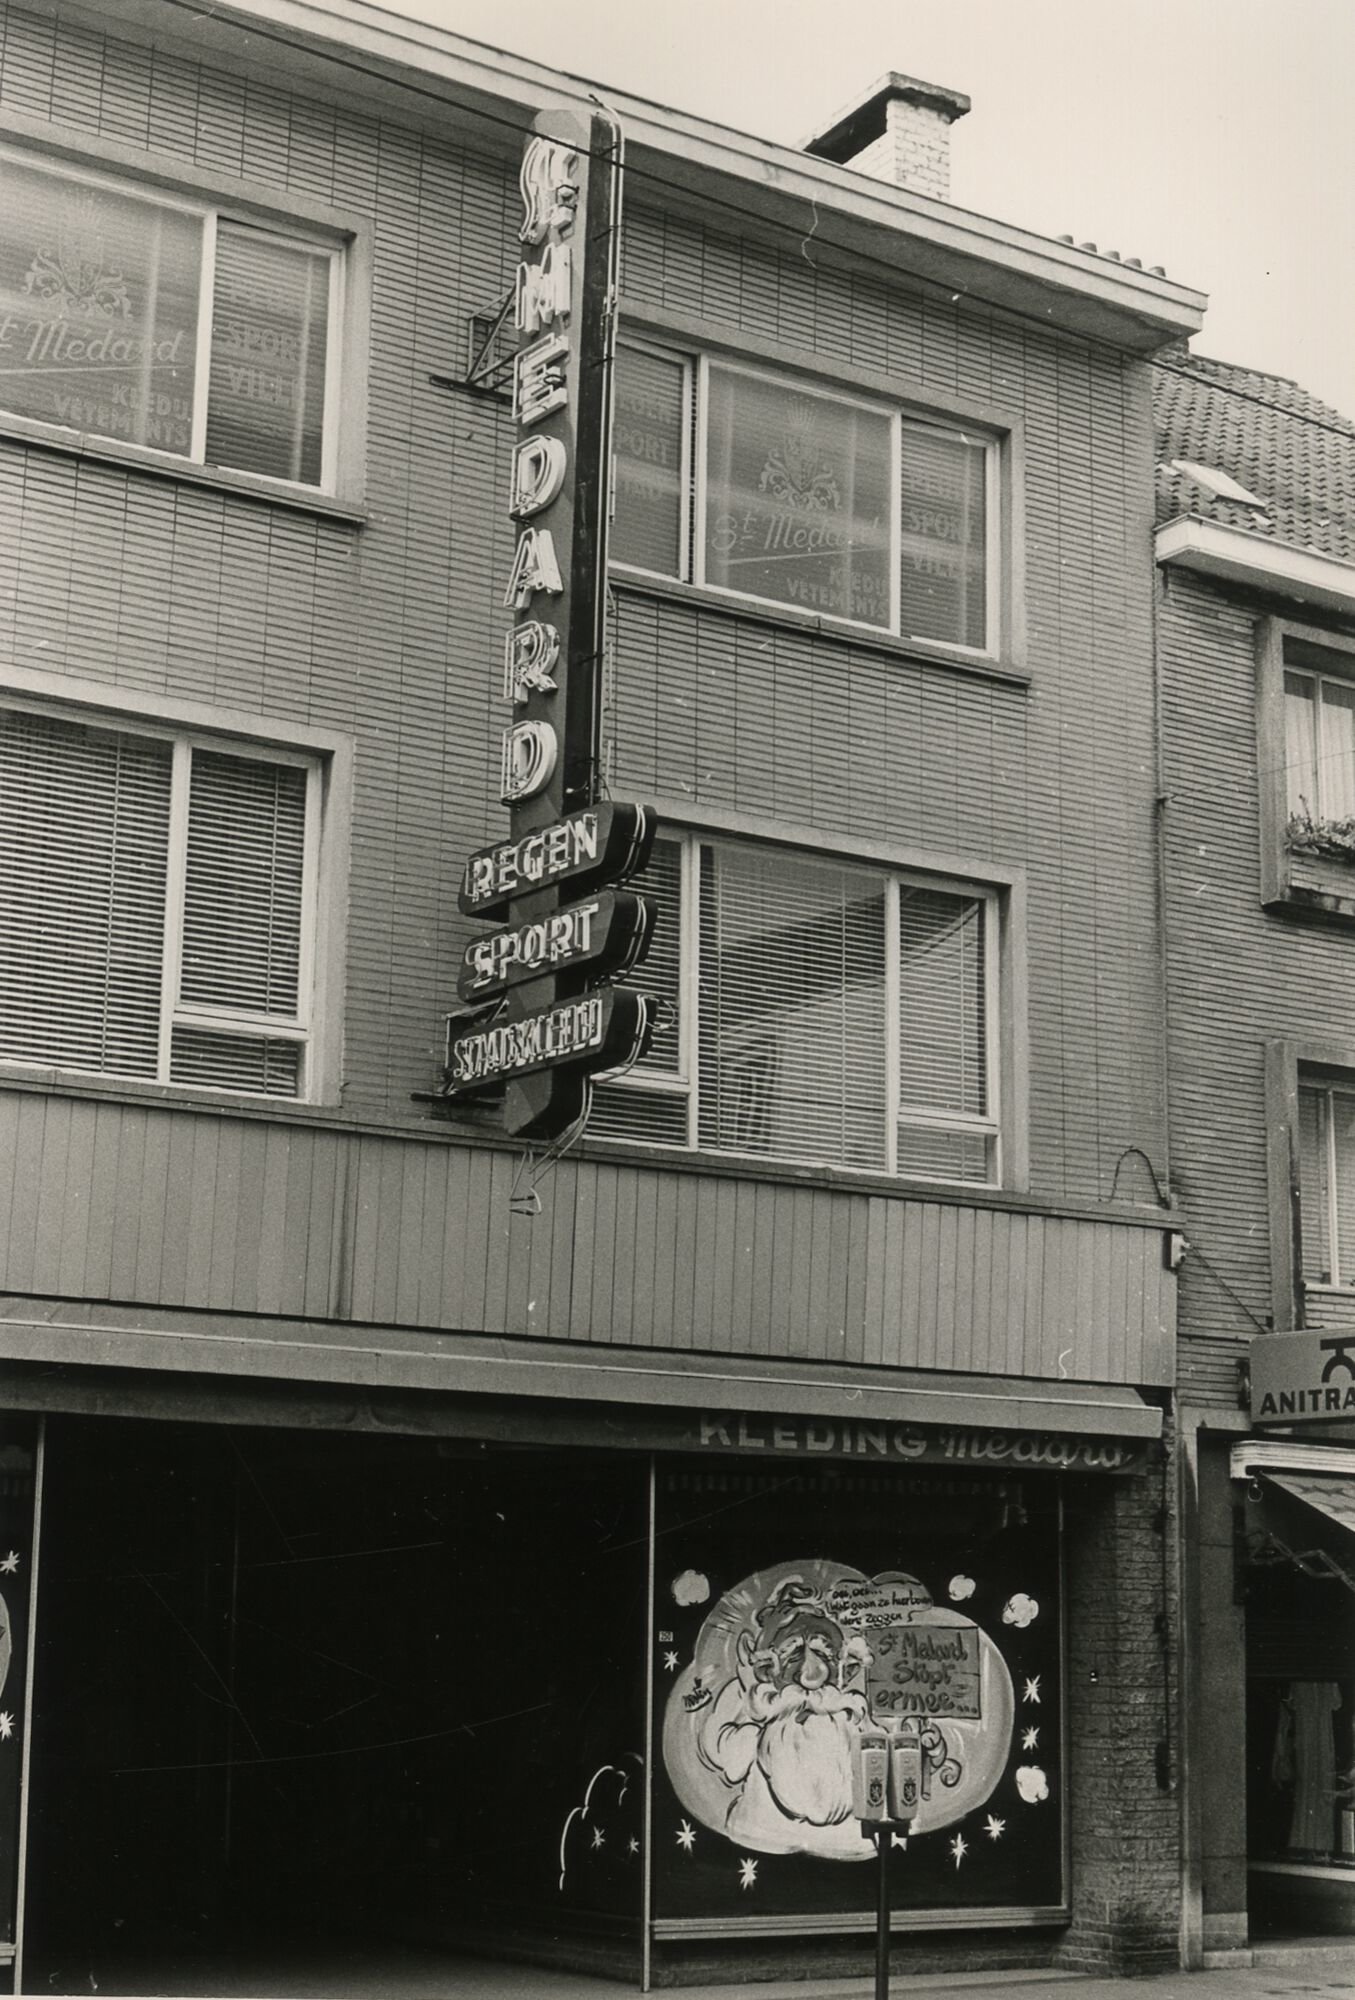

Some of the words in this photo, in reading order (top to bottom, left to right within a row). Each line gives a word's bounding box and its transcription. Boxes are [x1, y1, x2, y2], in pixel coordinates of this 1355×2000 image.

[230, 322, 306, 364] SPOR
[615, 424, 671, 465] PORT
[763, 511, 881, 550] Medad
[464, 812, 598, 903] REGEN
[464, 902, 599, 988] SPORT
[1260, 1387, 1355, 1415] ANITRA
[699, 1413, 927, 1459] KLEDING
